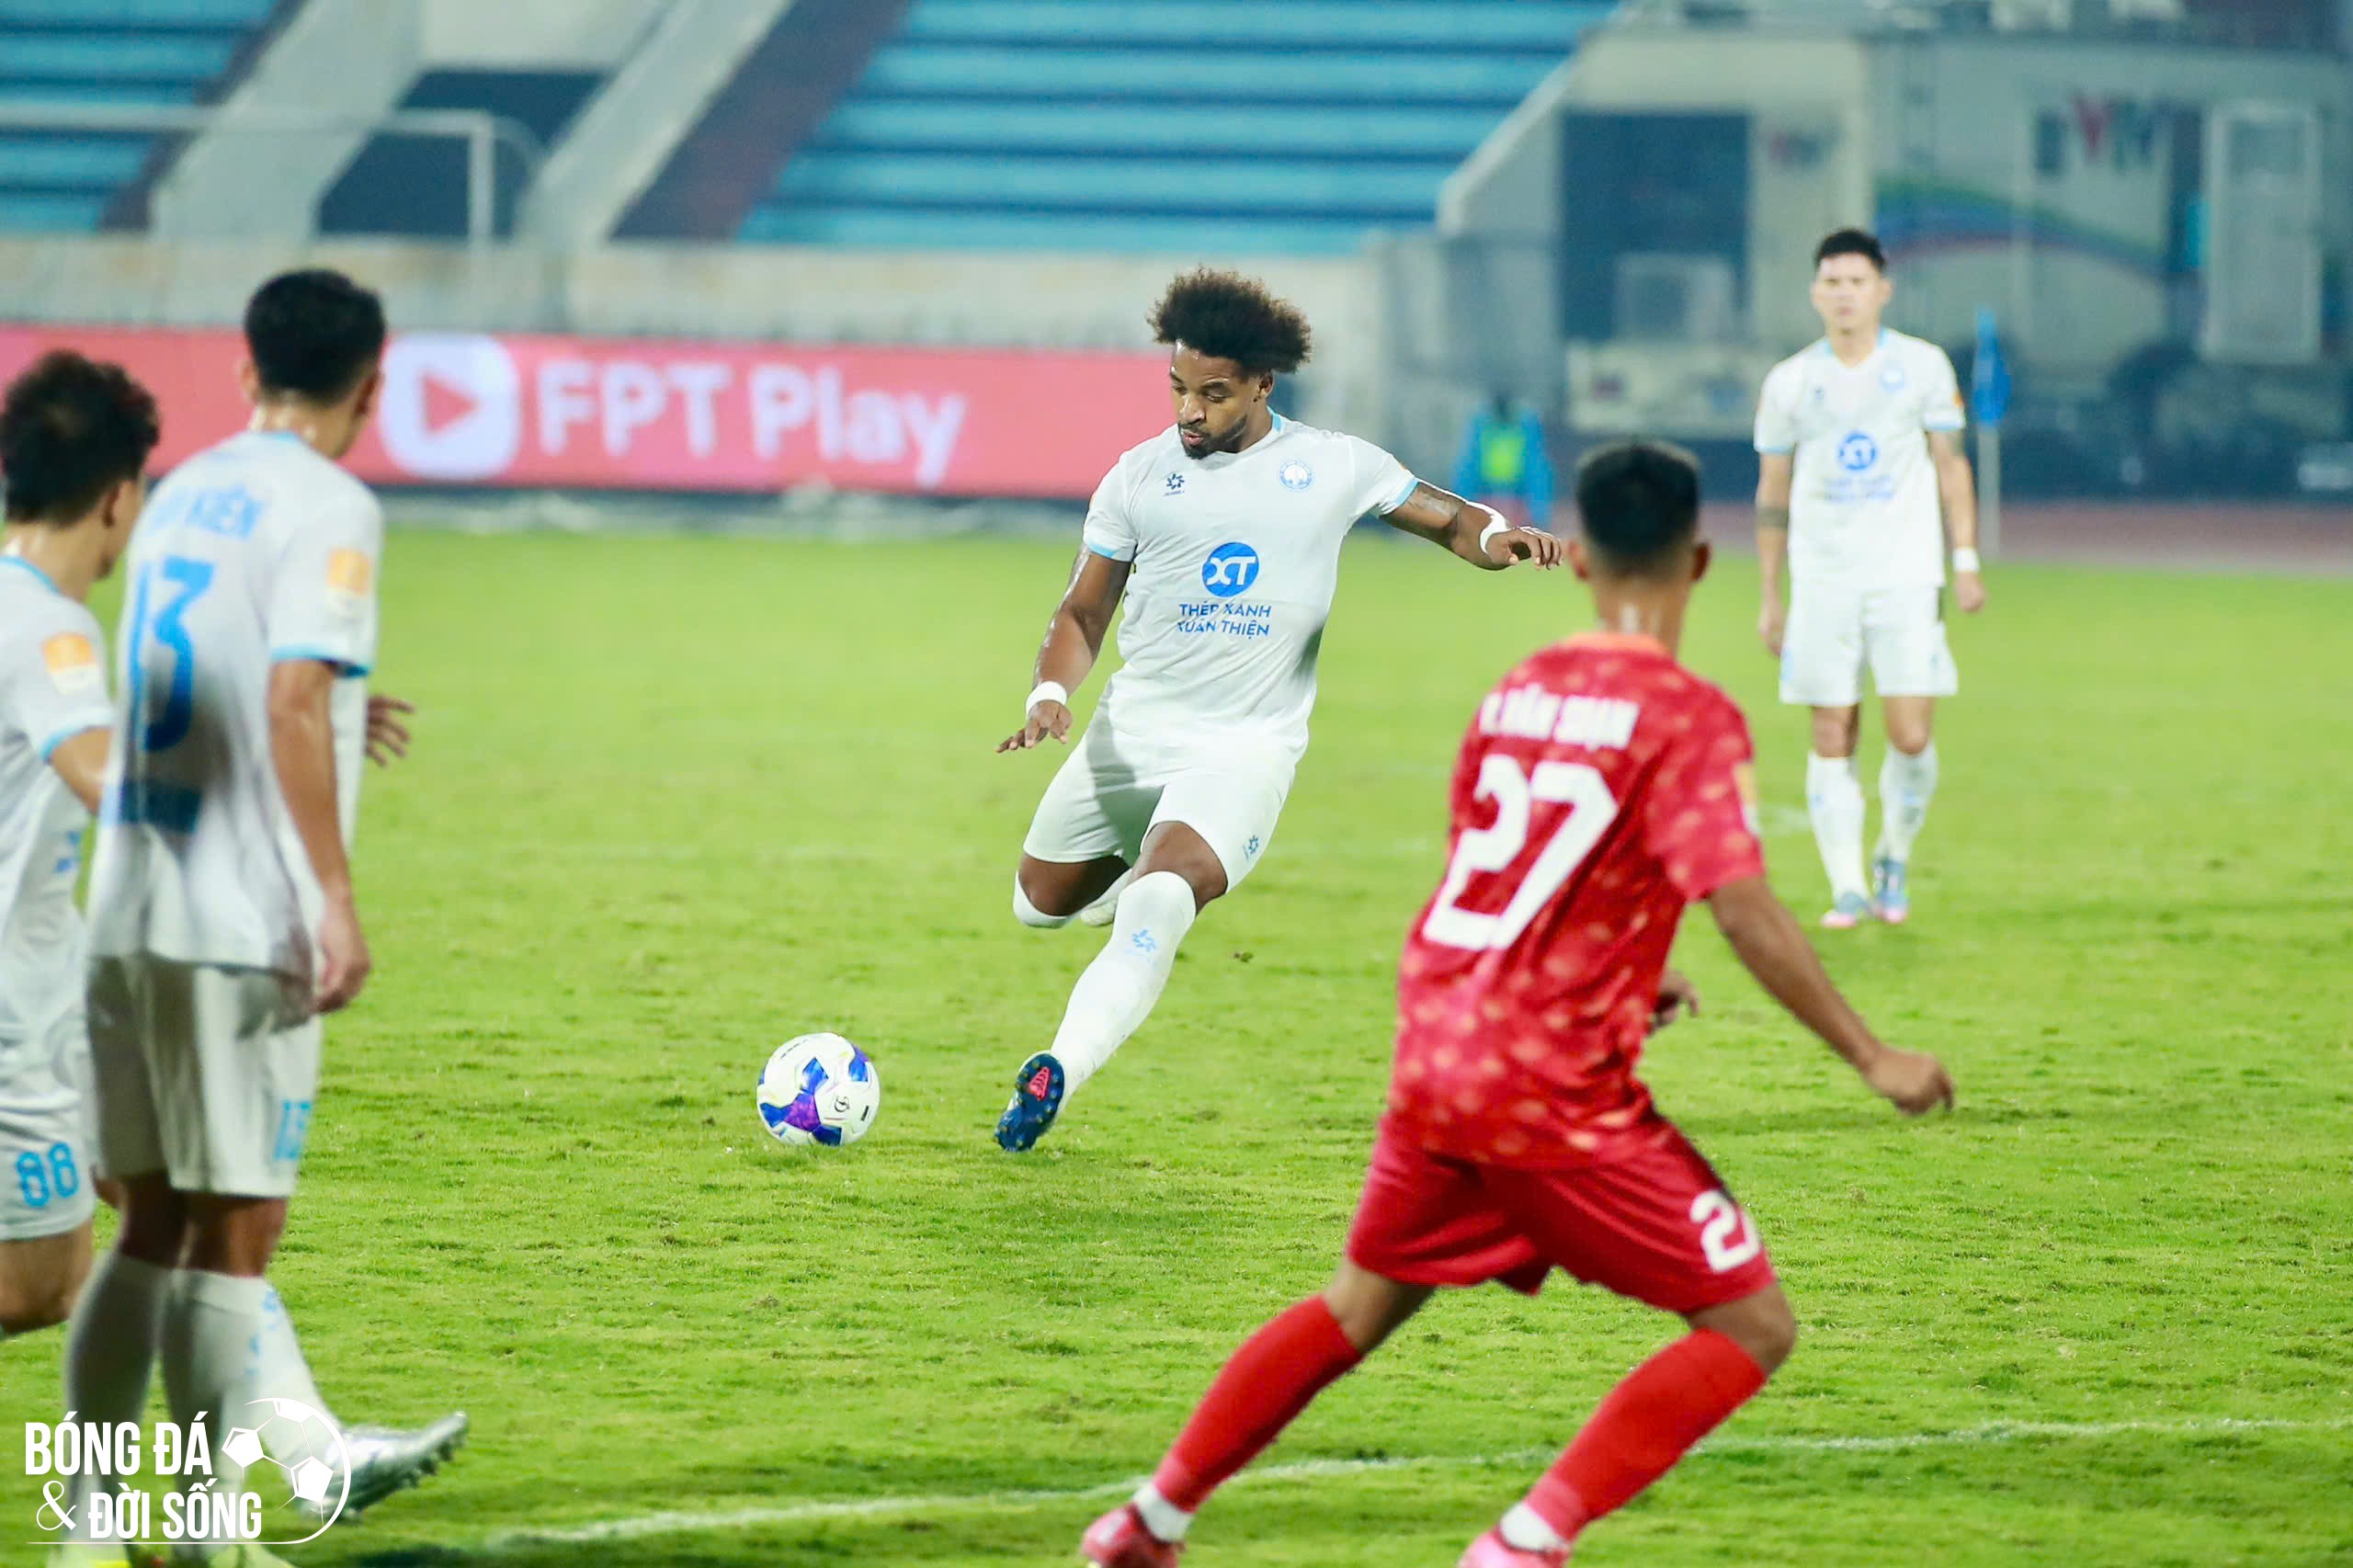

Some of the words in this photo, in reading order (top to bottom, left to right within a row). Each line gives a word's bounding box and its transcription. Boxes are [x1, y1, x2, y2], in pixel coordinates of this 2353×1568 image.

[536, 358, 732, 458] FPT
[748, 362, 968, 489] Play
[1206, 554, 1256, 586] XT
[1221, 619, 1270, 640] THIỆN
[1223, 603, 1272, 618] XANH
[126, 554, 215, 753] 13
[1421, 753, 1620, 950] 27
[15, 1142, 80, 1209] 88
